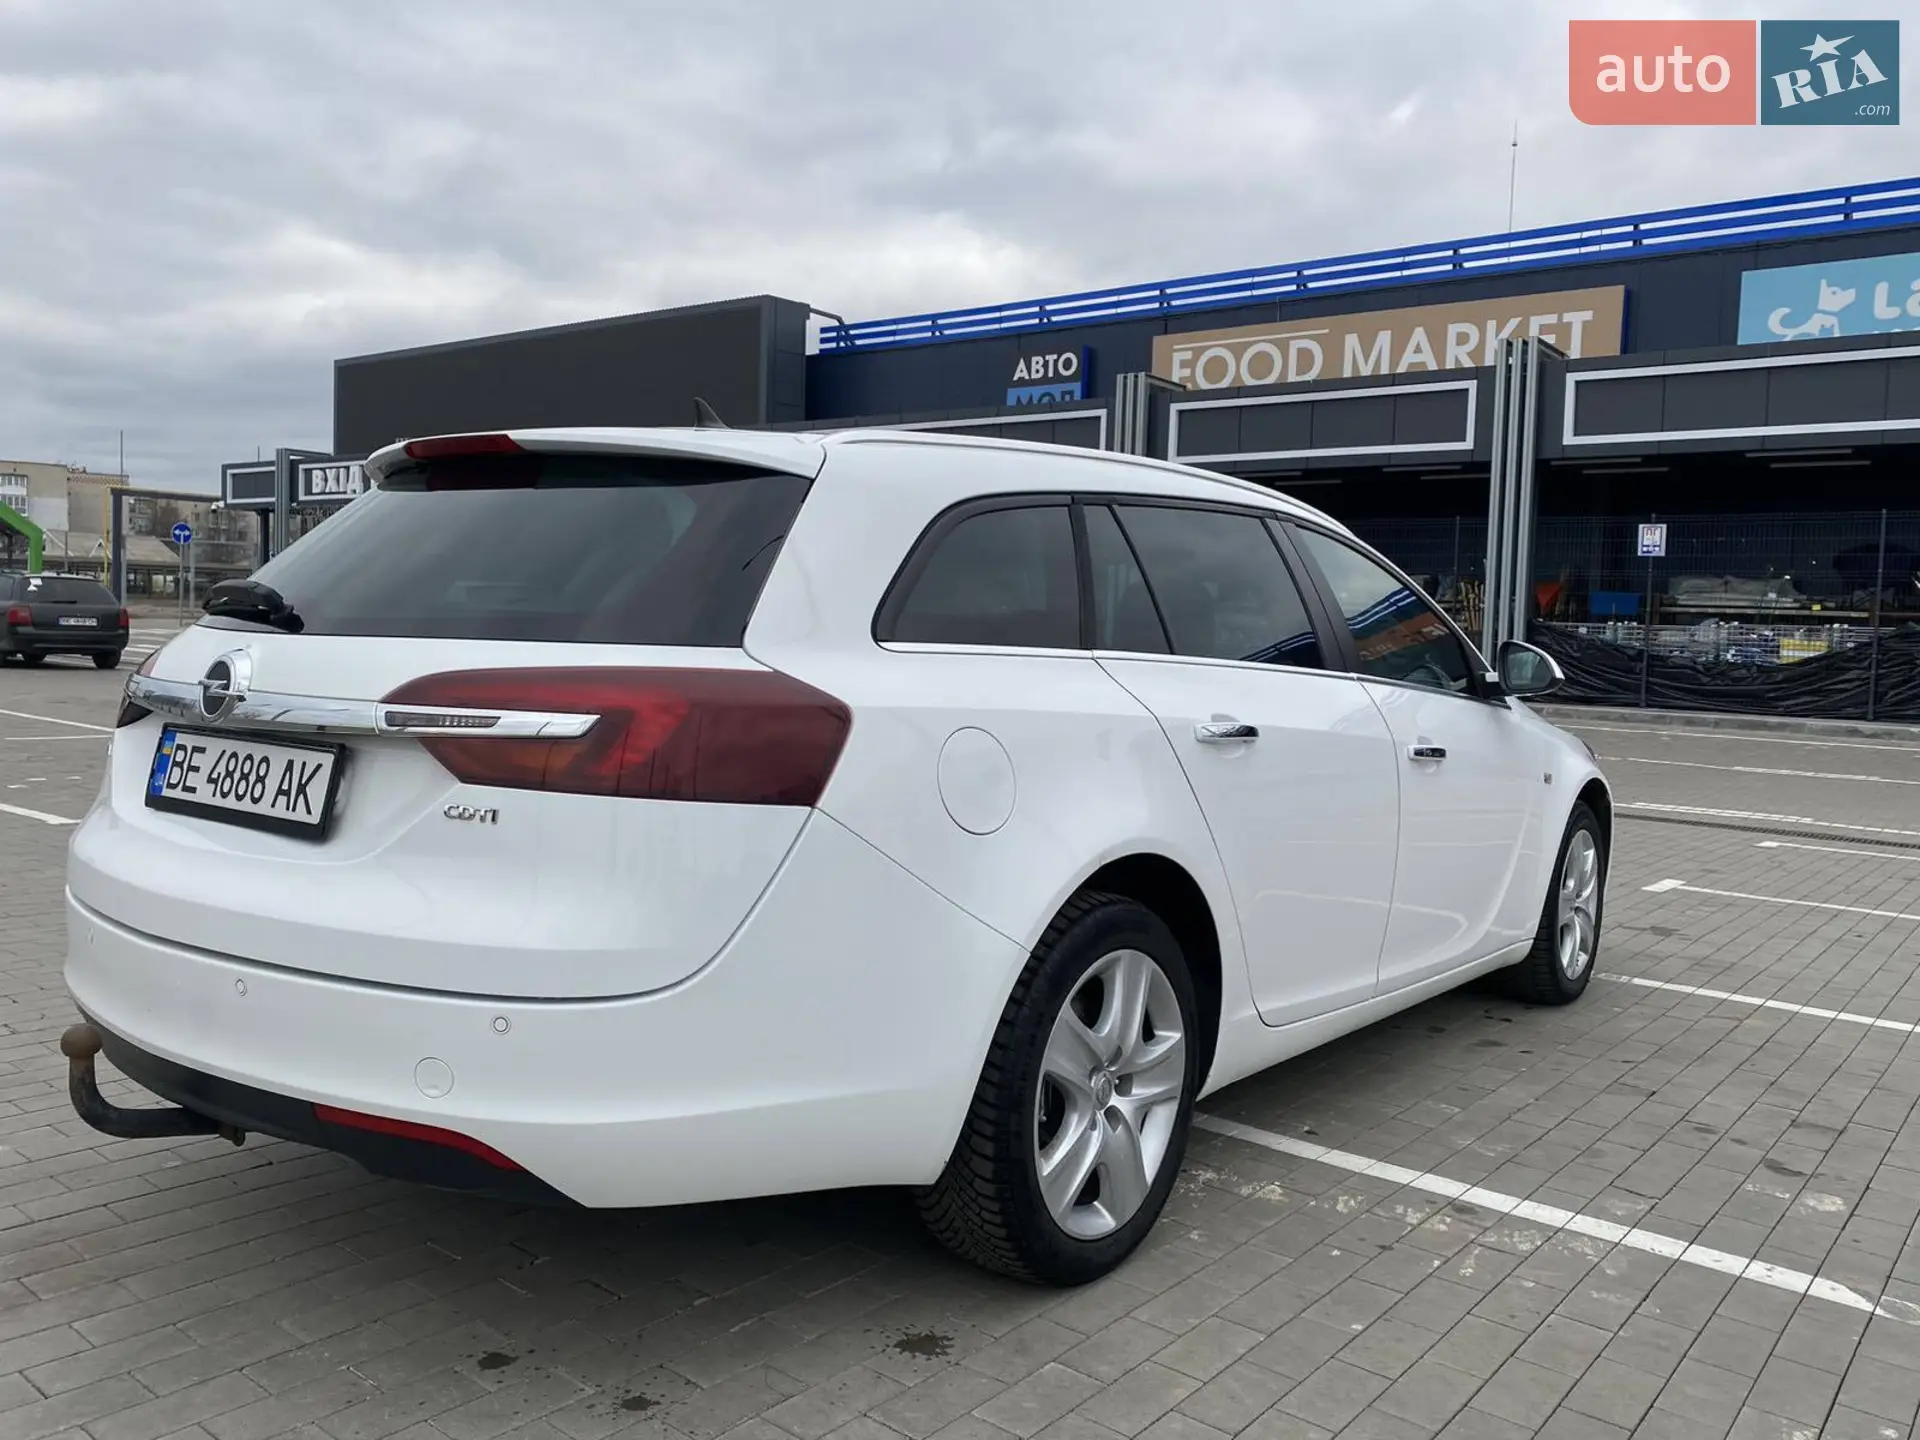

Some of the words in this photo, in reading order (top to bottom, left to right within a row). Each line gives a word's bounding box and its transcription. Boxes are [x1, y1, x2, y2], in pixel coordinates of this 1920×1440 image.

[1012, 352, 1078, 381] АВТО
[311, 464, 364, 495] ВХІД
[166, 743, 207, 794] BE
[206, 749, 271, 805] 4888
[270, 758, 324, 816] AK
